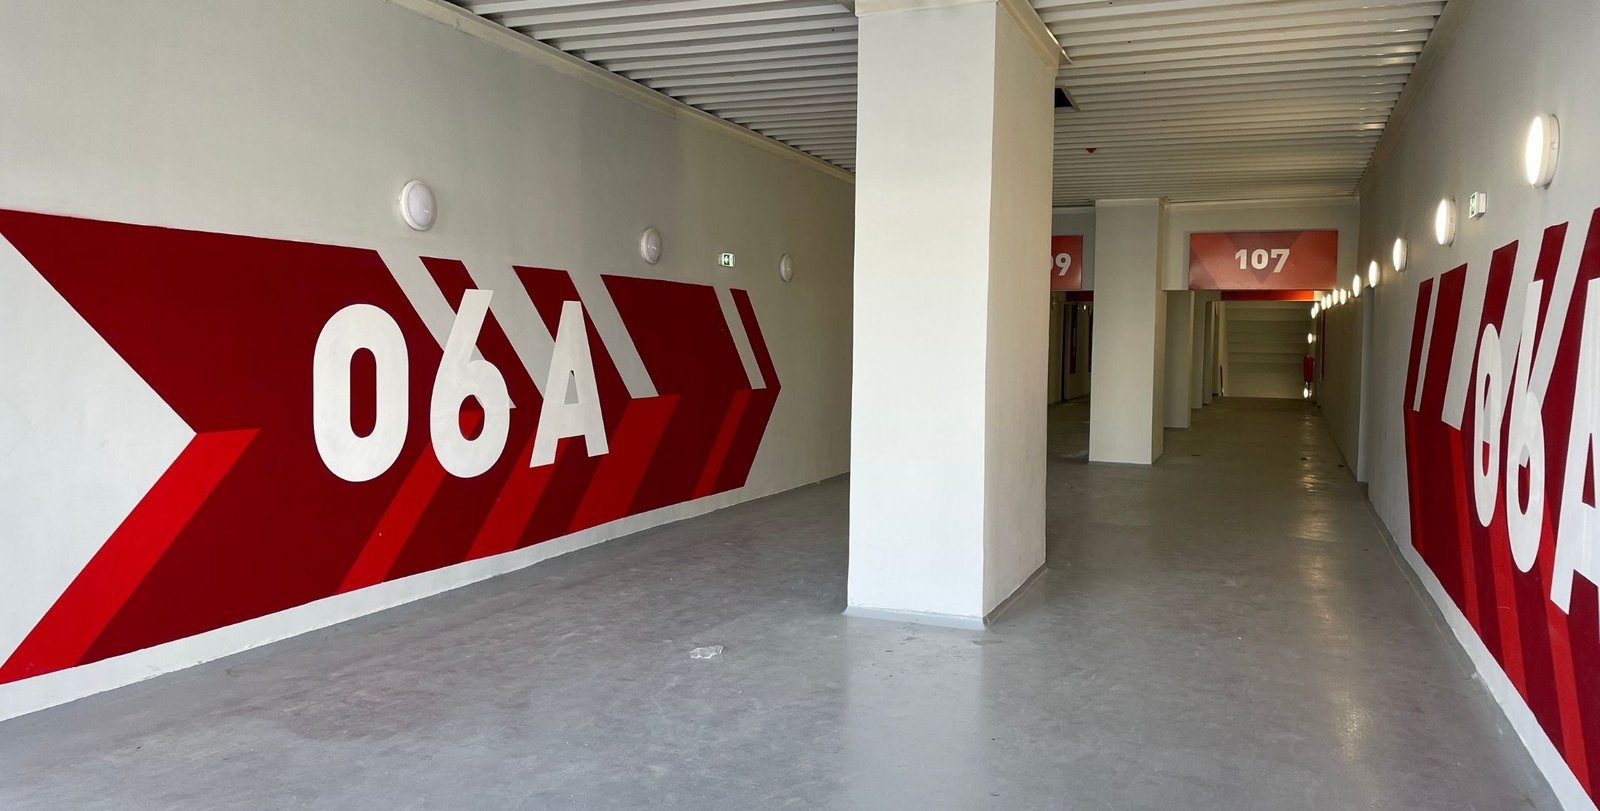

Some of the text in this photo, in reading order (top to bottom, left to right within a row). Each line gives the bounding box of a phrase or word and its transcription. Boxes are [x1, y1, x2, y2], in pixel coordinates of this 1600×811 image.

[1050, 252, 1072, 277] 9
[1235, 249, 1290, 272] 107
[313, 288, 609, 482] 06A
